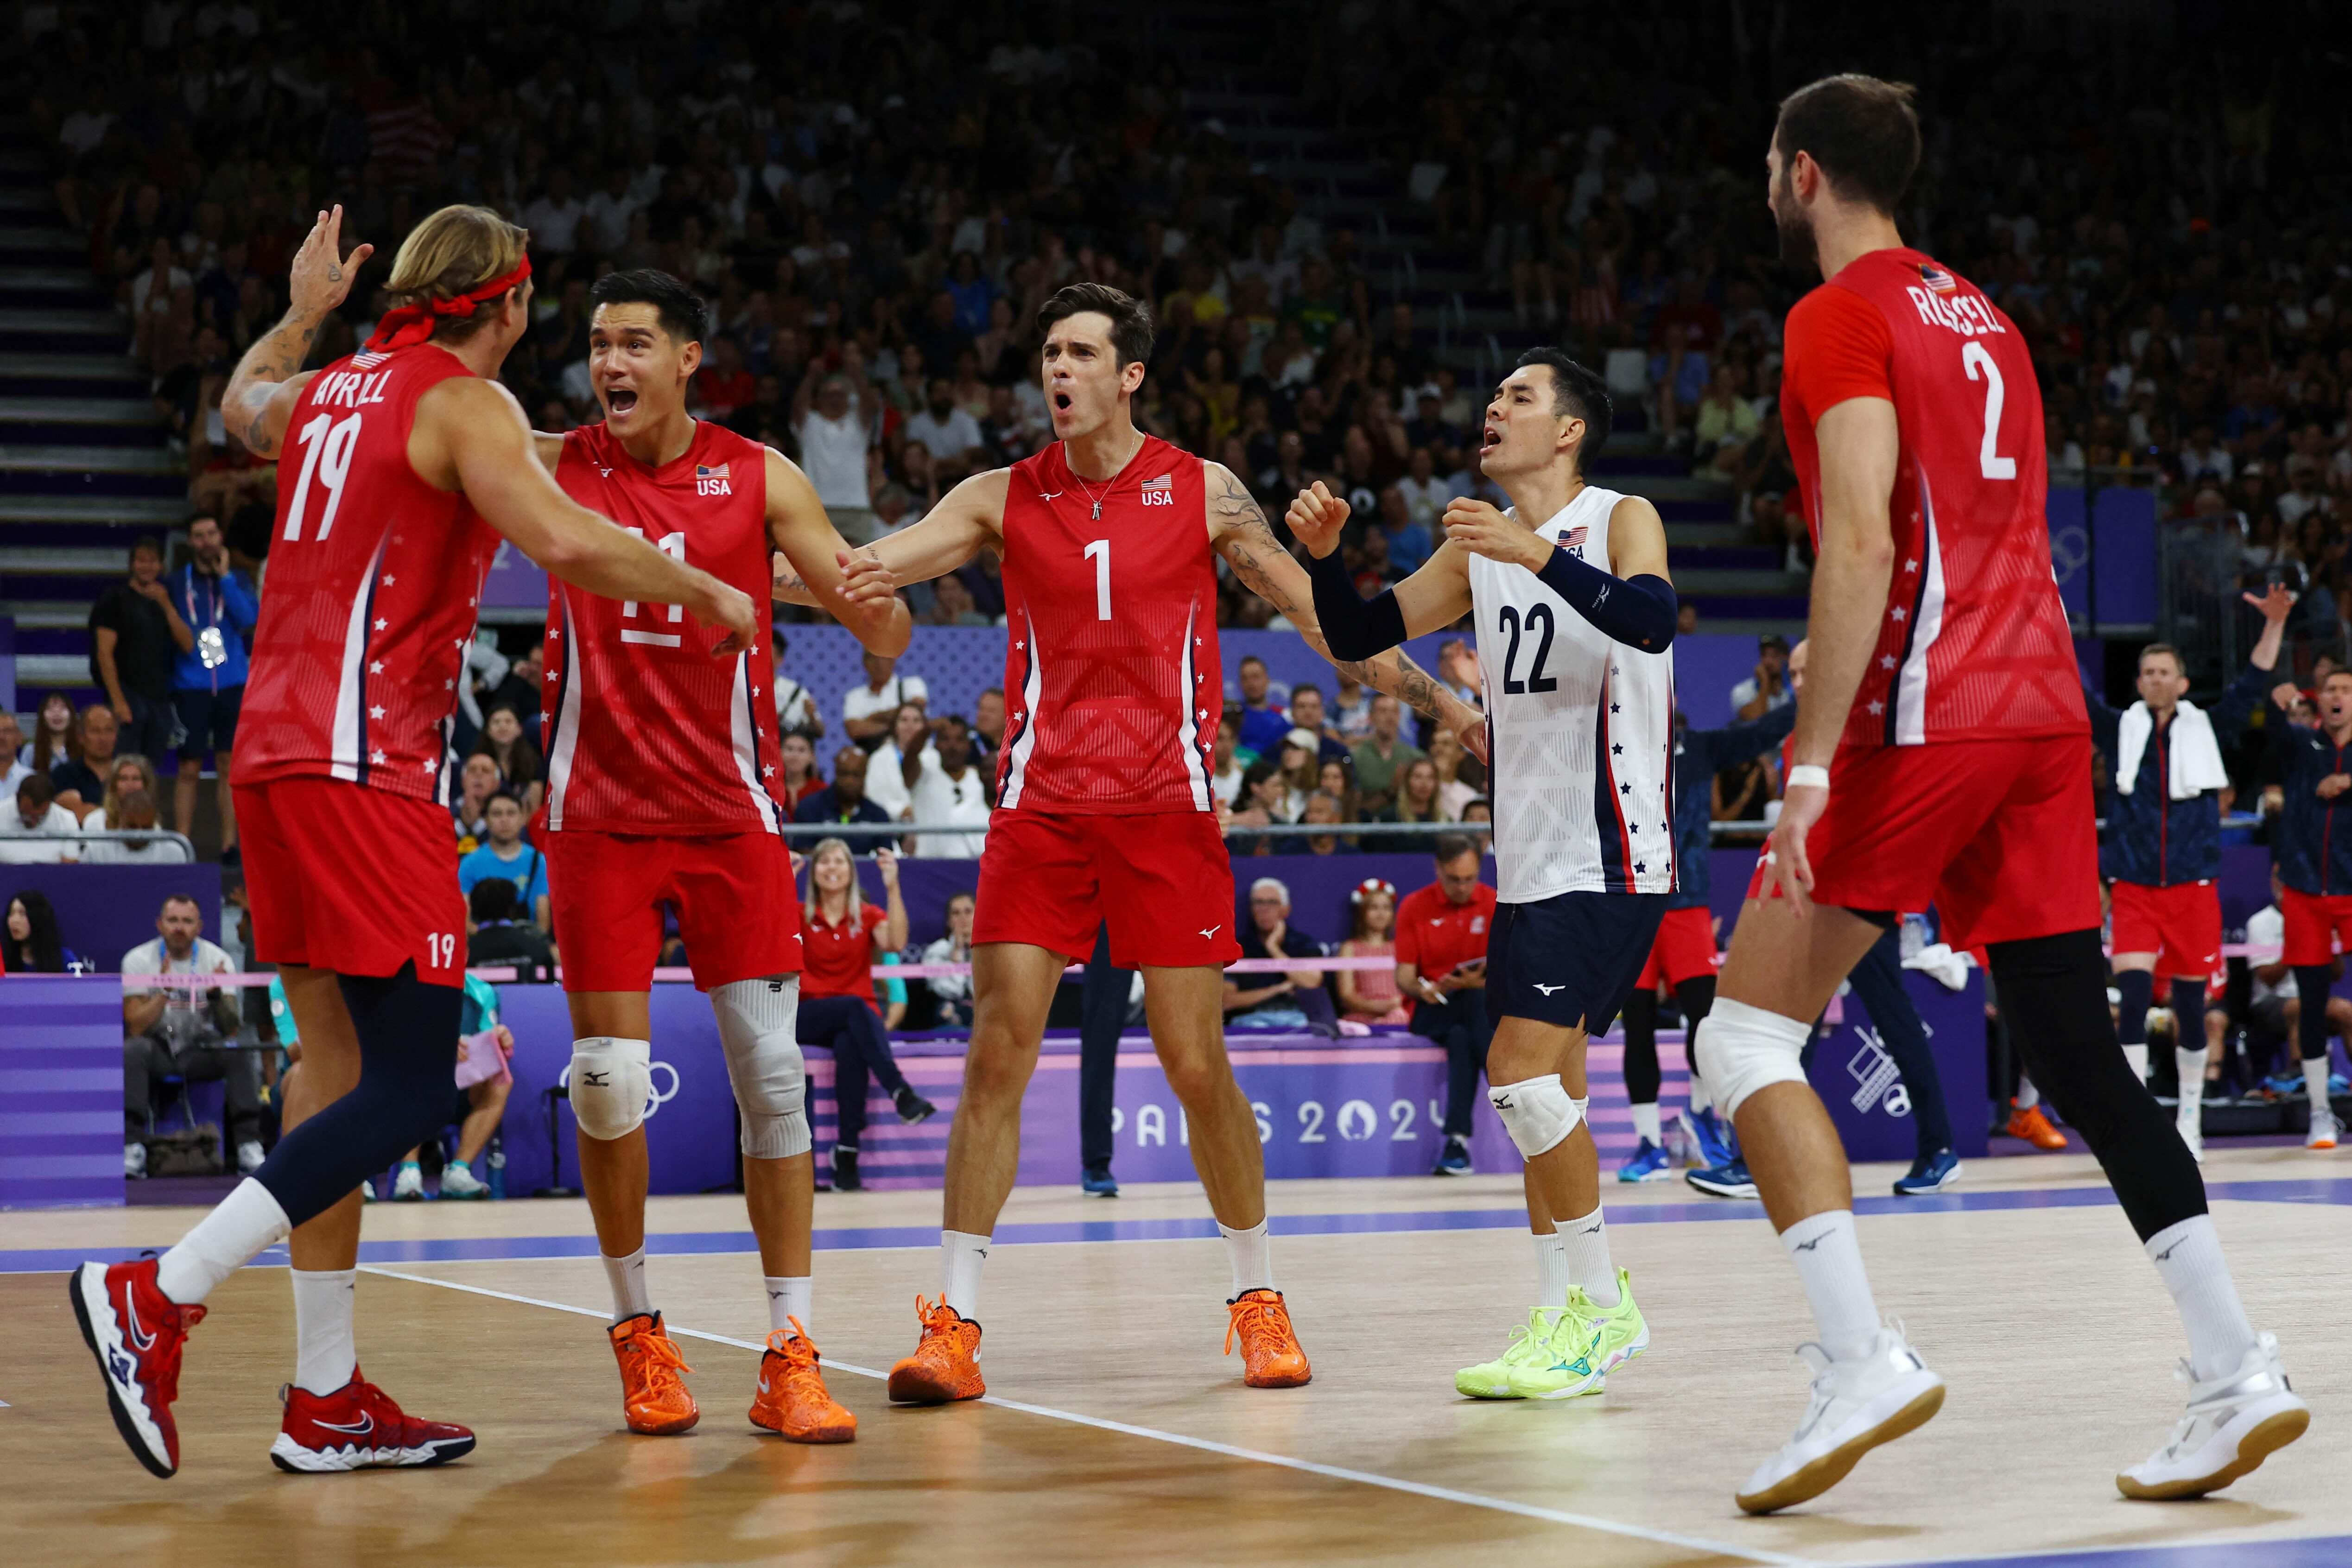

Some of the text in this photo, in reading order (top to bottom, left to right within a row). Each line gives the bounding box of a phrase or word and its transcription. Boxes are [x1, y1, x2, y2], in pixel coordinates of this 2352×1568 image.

[1962, 341, 2016, 480] 2
[283, 412, 362, 541] 19
[697, 479, 731, 496] USA
[1142, 490, 1173, 506] USA
[1083, 540, 1112, 621] 1
[1499, 603, 1557, 694] 22
[427, 932, 456, 969] 19
